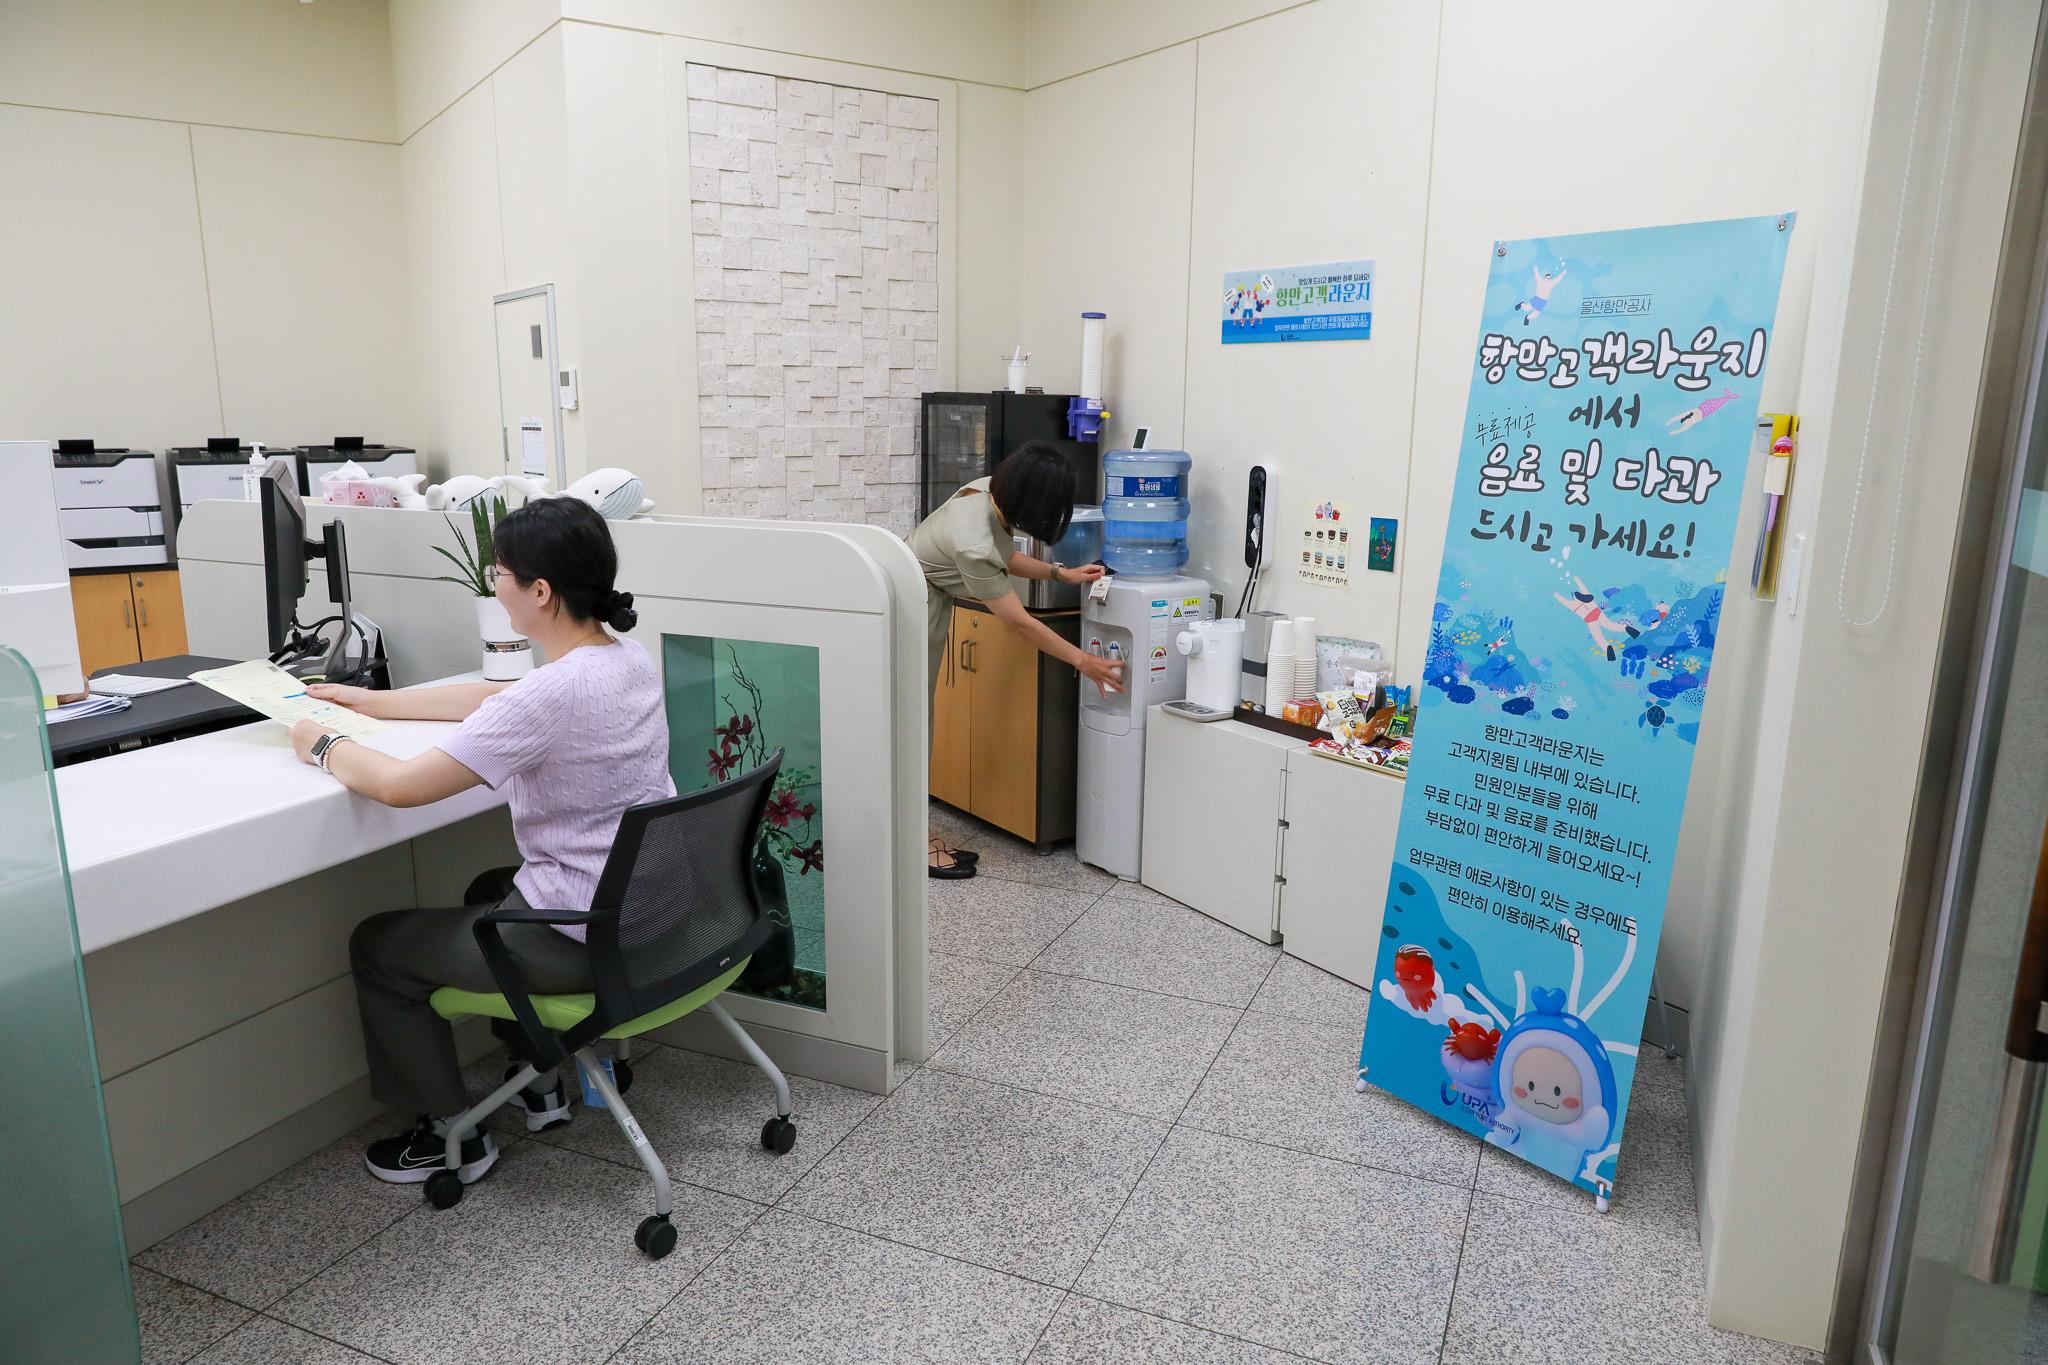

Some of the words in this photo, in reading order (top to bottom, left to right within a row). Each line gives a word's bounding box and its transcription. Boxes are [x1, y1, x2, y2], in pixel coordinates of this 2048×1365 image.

[1276, 282, 1370, 307] 항만고객라운지
[1580, 298, 1651, 315] 울산항만공사
[1480, 326, 1766, 390] 항만고객라운지
[1474, 411, 1537, 446] 무료제공
[1569, 393, 1641, 429] 에서
[1479, 443, 1544, 496] 음료
[1561, 439, 1602, 505] 및
[1613, 448, 1721, 504] 다과
[1471, 509, 1553, 552] 드시고
[1569, 513, 1696, 559] 가세요!
[1484, 724, 1605, 767] 항만고객라운지는
[1448, 741, 1518, 773] 고객지원팀
[1523, 759, 1569, 785] 내부에
[1574, 771, 1641, 804] 있습니다.
[1474, 773, 1562, 811] 민원인분들을
[1567, 796, 1599, 820] 위해
[1423, 785, 1450, 805] 무료
[1454, 792, 1482, 815] 다과
[1486, 800, 1500, 820] 및
[1504, 807, 1548, 834] 음료를
[1552, 819, 1652, 864] 준비했습니다.
[1425, 810, 1480, 840] 부담없이
[1483, 826, 1543, 859] 편안하게
[1546, 845, 1642, 889] 들어오세요~!
[1409, 848, 1462, 878] 업무관련
[1465, 865, 1536, 903] 애로사항이
[1540, 890, 1570, 914] 있는
[1574, 902, 1638, 937] 경우에도
[1447, 886, 1489, 914] 편안히
[1492, 902, 1583, 947] 이용해주세요.
[1462, 1092, 1490, 1117] UPA
